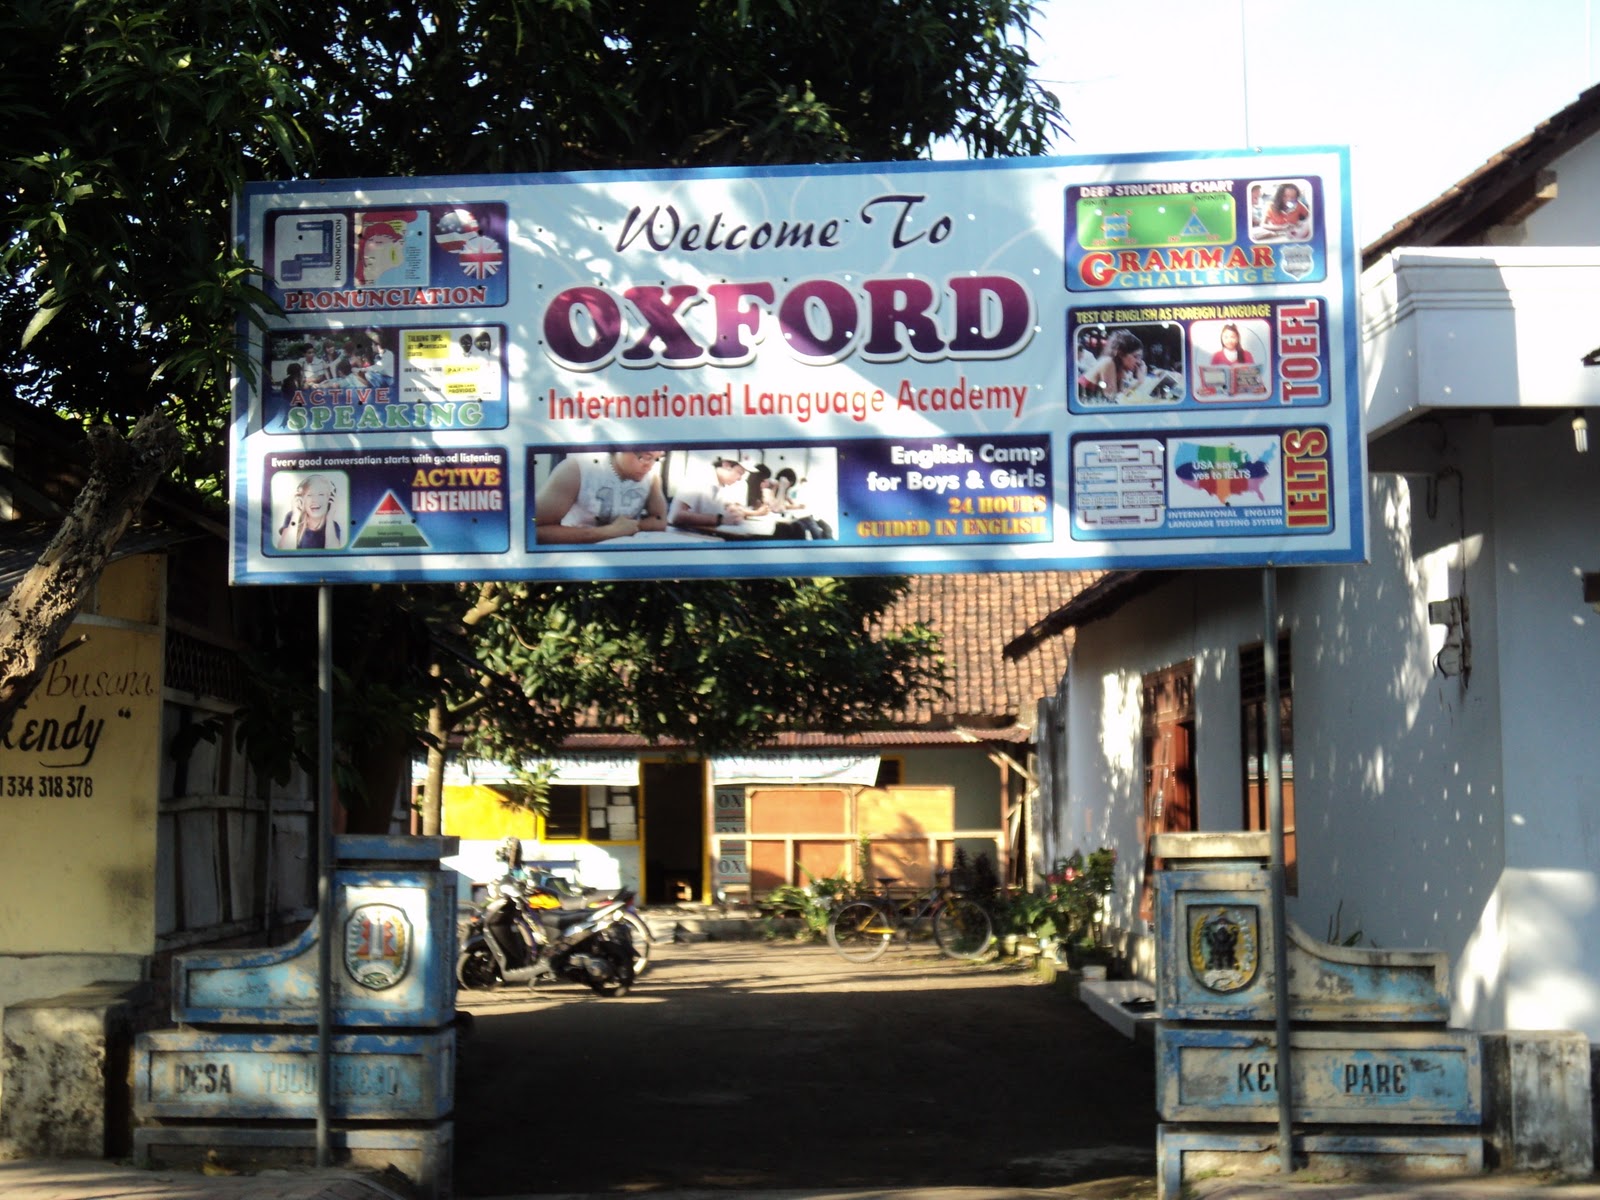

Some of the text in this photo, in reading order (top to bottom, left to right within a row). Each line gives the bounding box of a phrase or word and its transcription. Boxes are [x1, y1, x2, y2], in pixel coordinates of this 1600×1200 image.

[1080, 180, 1234, 198] DEEP STRUCTURE CHART
[615, 194, 953, 253] Welcome To
[1079, 245, 1277, 289] GRAMMAR
[1119, 268, 1277, 288] CHALLENGE
[284, 287, 487, 312] PRONUNCIATION
[543, 274, 1034, 368] OXFORD
[1076, 304, 1271, 323] TEST OF ENGLISH AS FOREIGN LANGUAGE
[1277, 299, 1321, 405] TOEFL
[290, 387, 391, 406] ACTIVE
[548, 376, 1028, 423] International Language Academy
[288, 402, 483, 430] SPEAKING
[271, 453, 501, 468] Every good conversation starts with good listening
[891, 443, 1046, 467] English Camp
[1192, 461, 1214, 470] USA
[412, 468, 501, 487] ACTIVE
[867, 468, 1046, 493] for Boys & Girls
[1192, 469, 1251, 481] yes to IELTS
[1282, 428, 1329, 529] IELTS
[412, 490, 502, 512] LISTENING
[948, 495, 1047, 514] 24 HOURS
[1168, 508, 1283, 519] INTERNATIONAL ENGLISH
[1168, 518, 1283, 529] LANGUAGE TESTING SYSTEM
[856, 516, 1047, 539] GUIDED IN ENGLISH
[7, 775, 35, 798] 334
[39, 775, 63, 798] 318
[66, 775, 93, 798] 378
[174, 1063, 233, 1094] DESA
[1238, 1062, 1407, 1095] KE PARE
